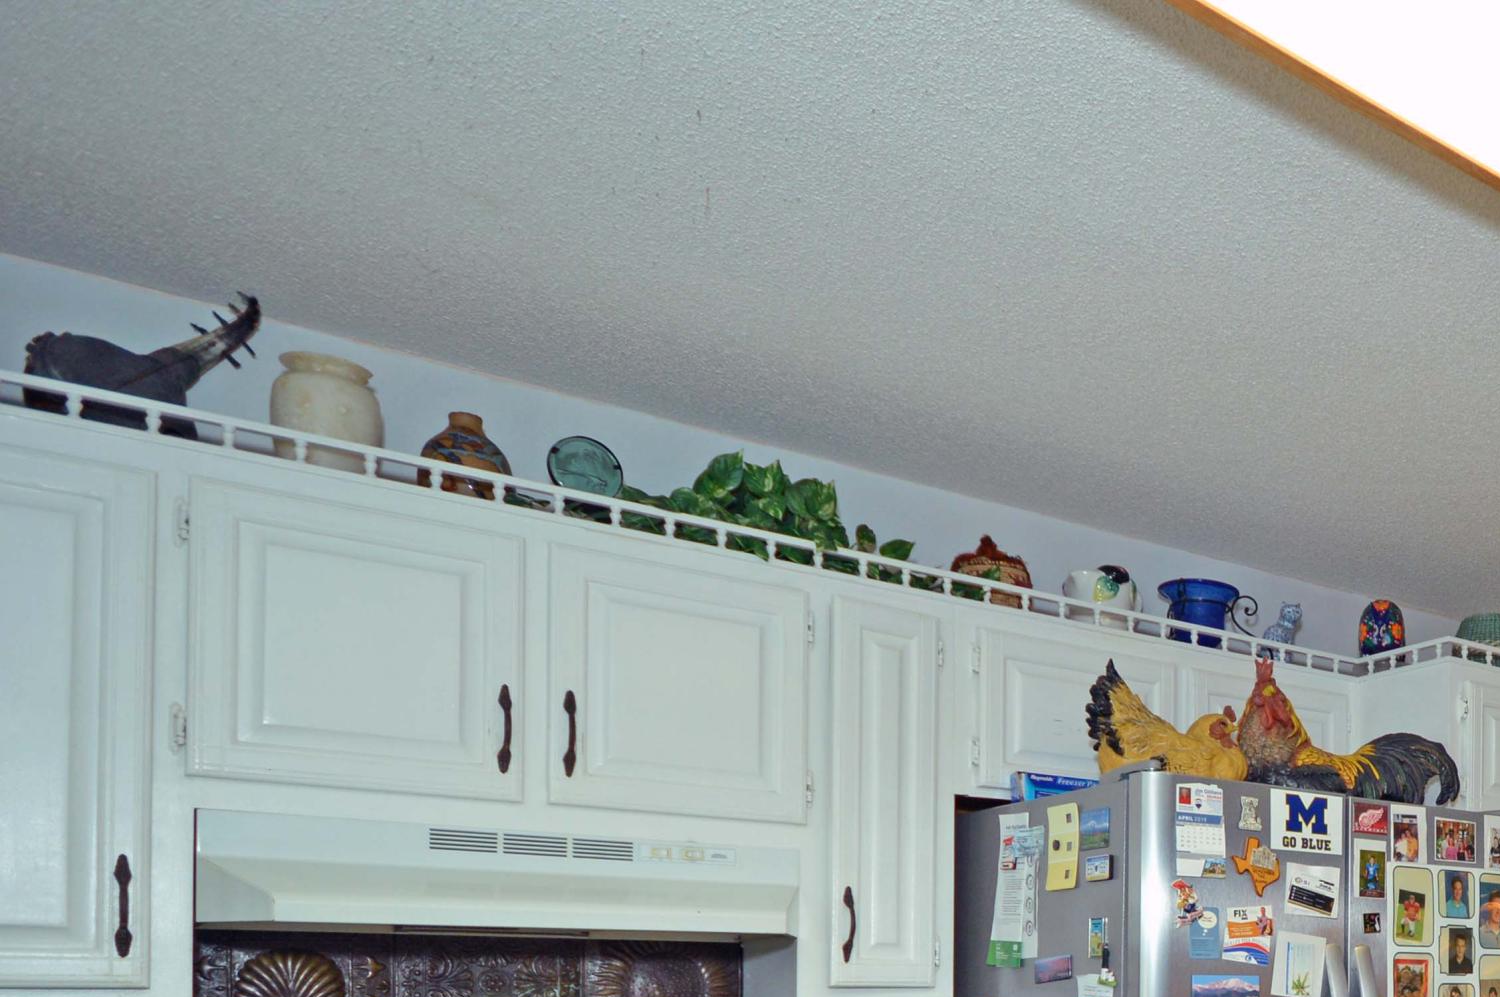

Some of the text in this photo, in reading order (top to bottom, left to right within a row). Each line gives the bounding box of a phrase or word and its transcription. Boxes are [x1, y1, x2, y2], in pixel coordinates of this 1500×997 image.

[1178, 814, 1194, 822] APRIL
[1285, 793, 1328, 835] M
[1282, 836, 1332, 851] GO BLUE
[1233, 909, 1248, 917] FIX
